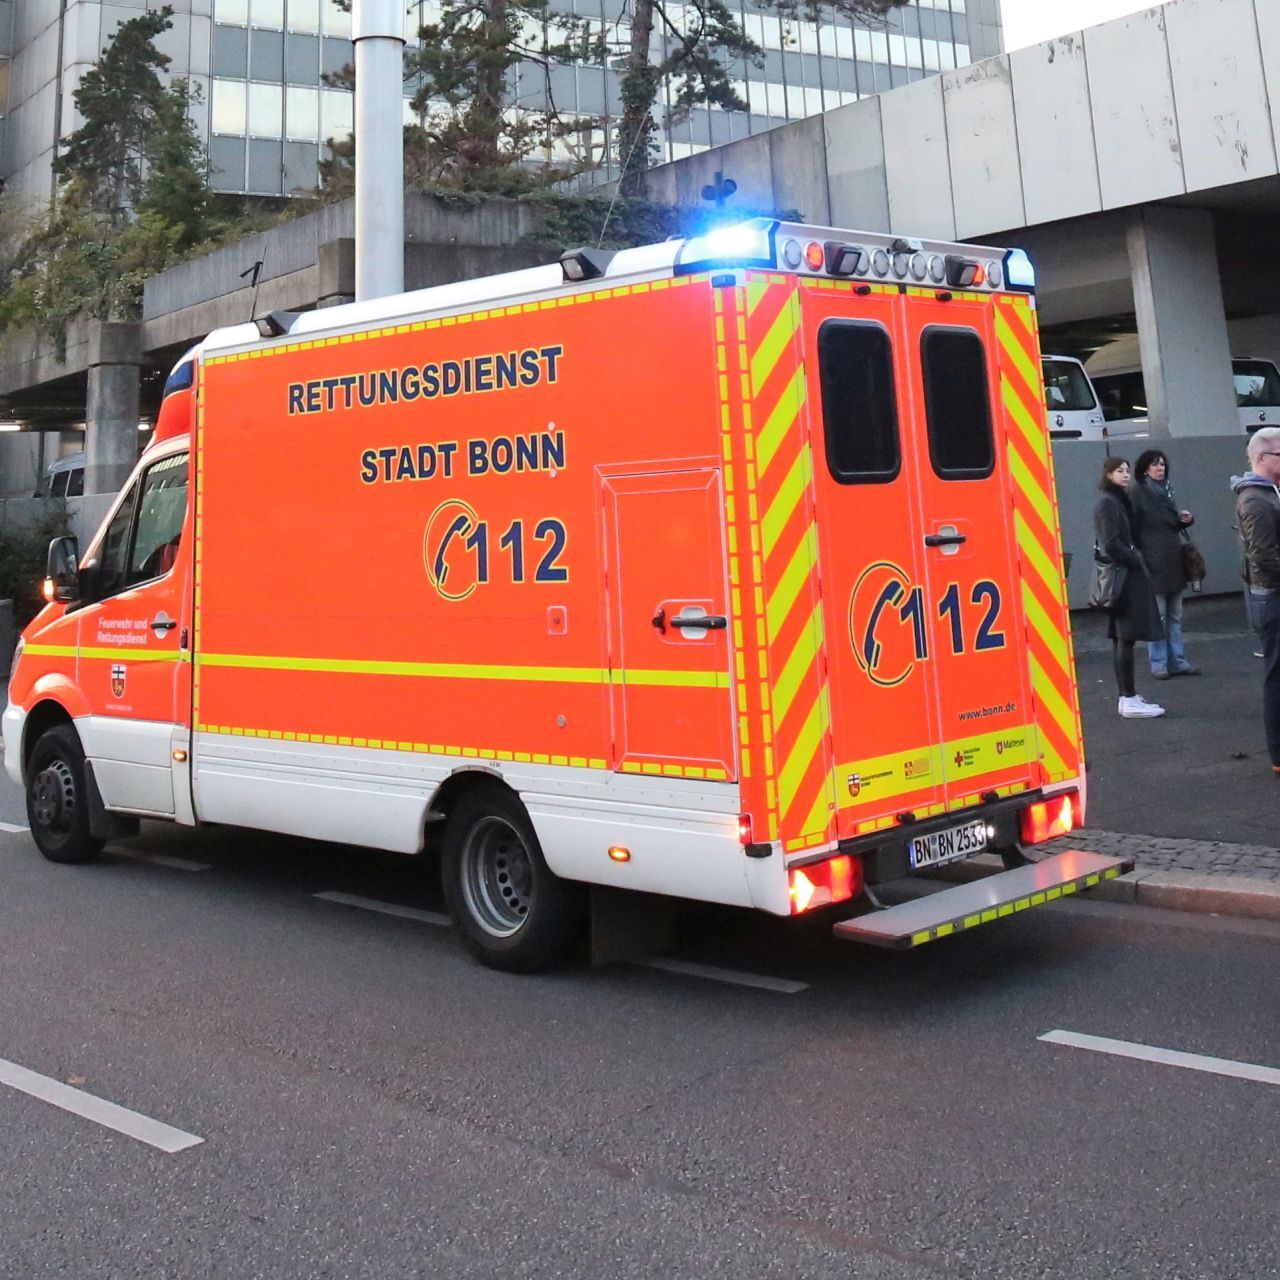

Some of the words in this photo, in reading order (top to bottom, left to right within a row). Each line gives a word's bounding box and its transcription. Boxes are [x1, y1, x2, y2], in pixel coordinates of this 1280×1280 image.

[288, 345, 562, 415] RETTUNGSDIENST
[361, 441, 458, 483] STADT
[467, 430, 565, 476] BONN
[465, 517, 568, 584] 112
[97, 631, 147, 646] Rettungsdienst
[98, 616, 133, 629] Feuerwehr
[134, 617, 148, 629] und
[900, 579, 1006, 661] 112
[958, 702, 1016, 721] www.bonn.de
[914, 837, 932, 864] BN
[938, 831, 955, 857] BN
